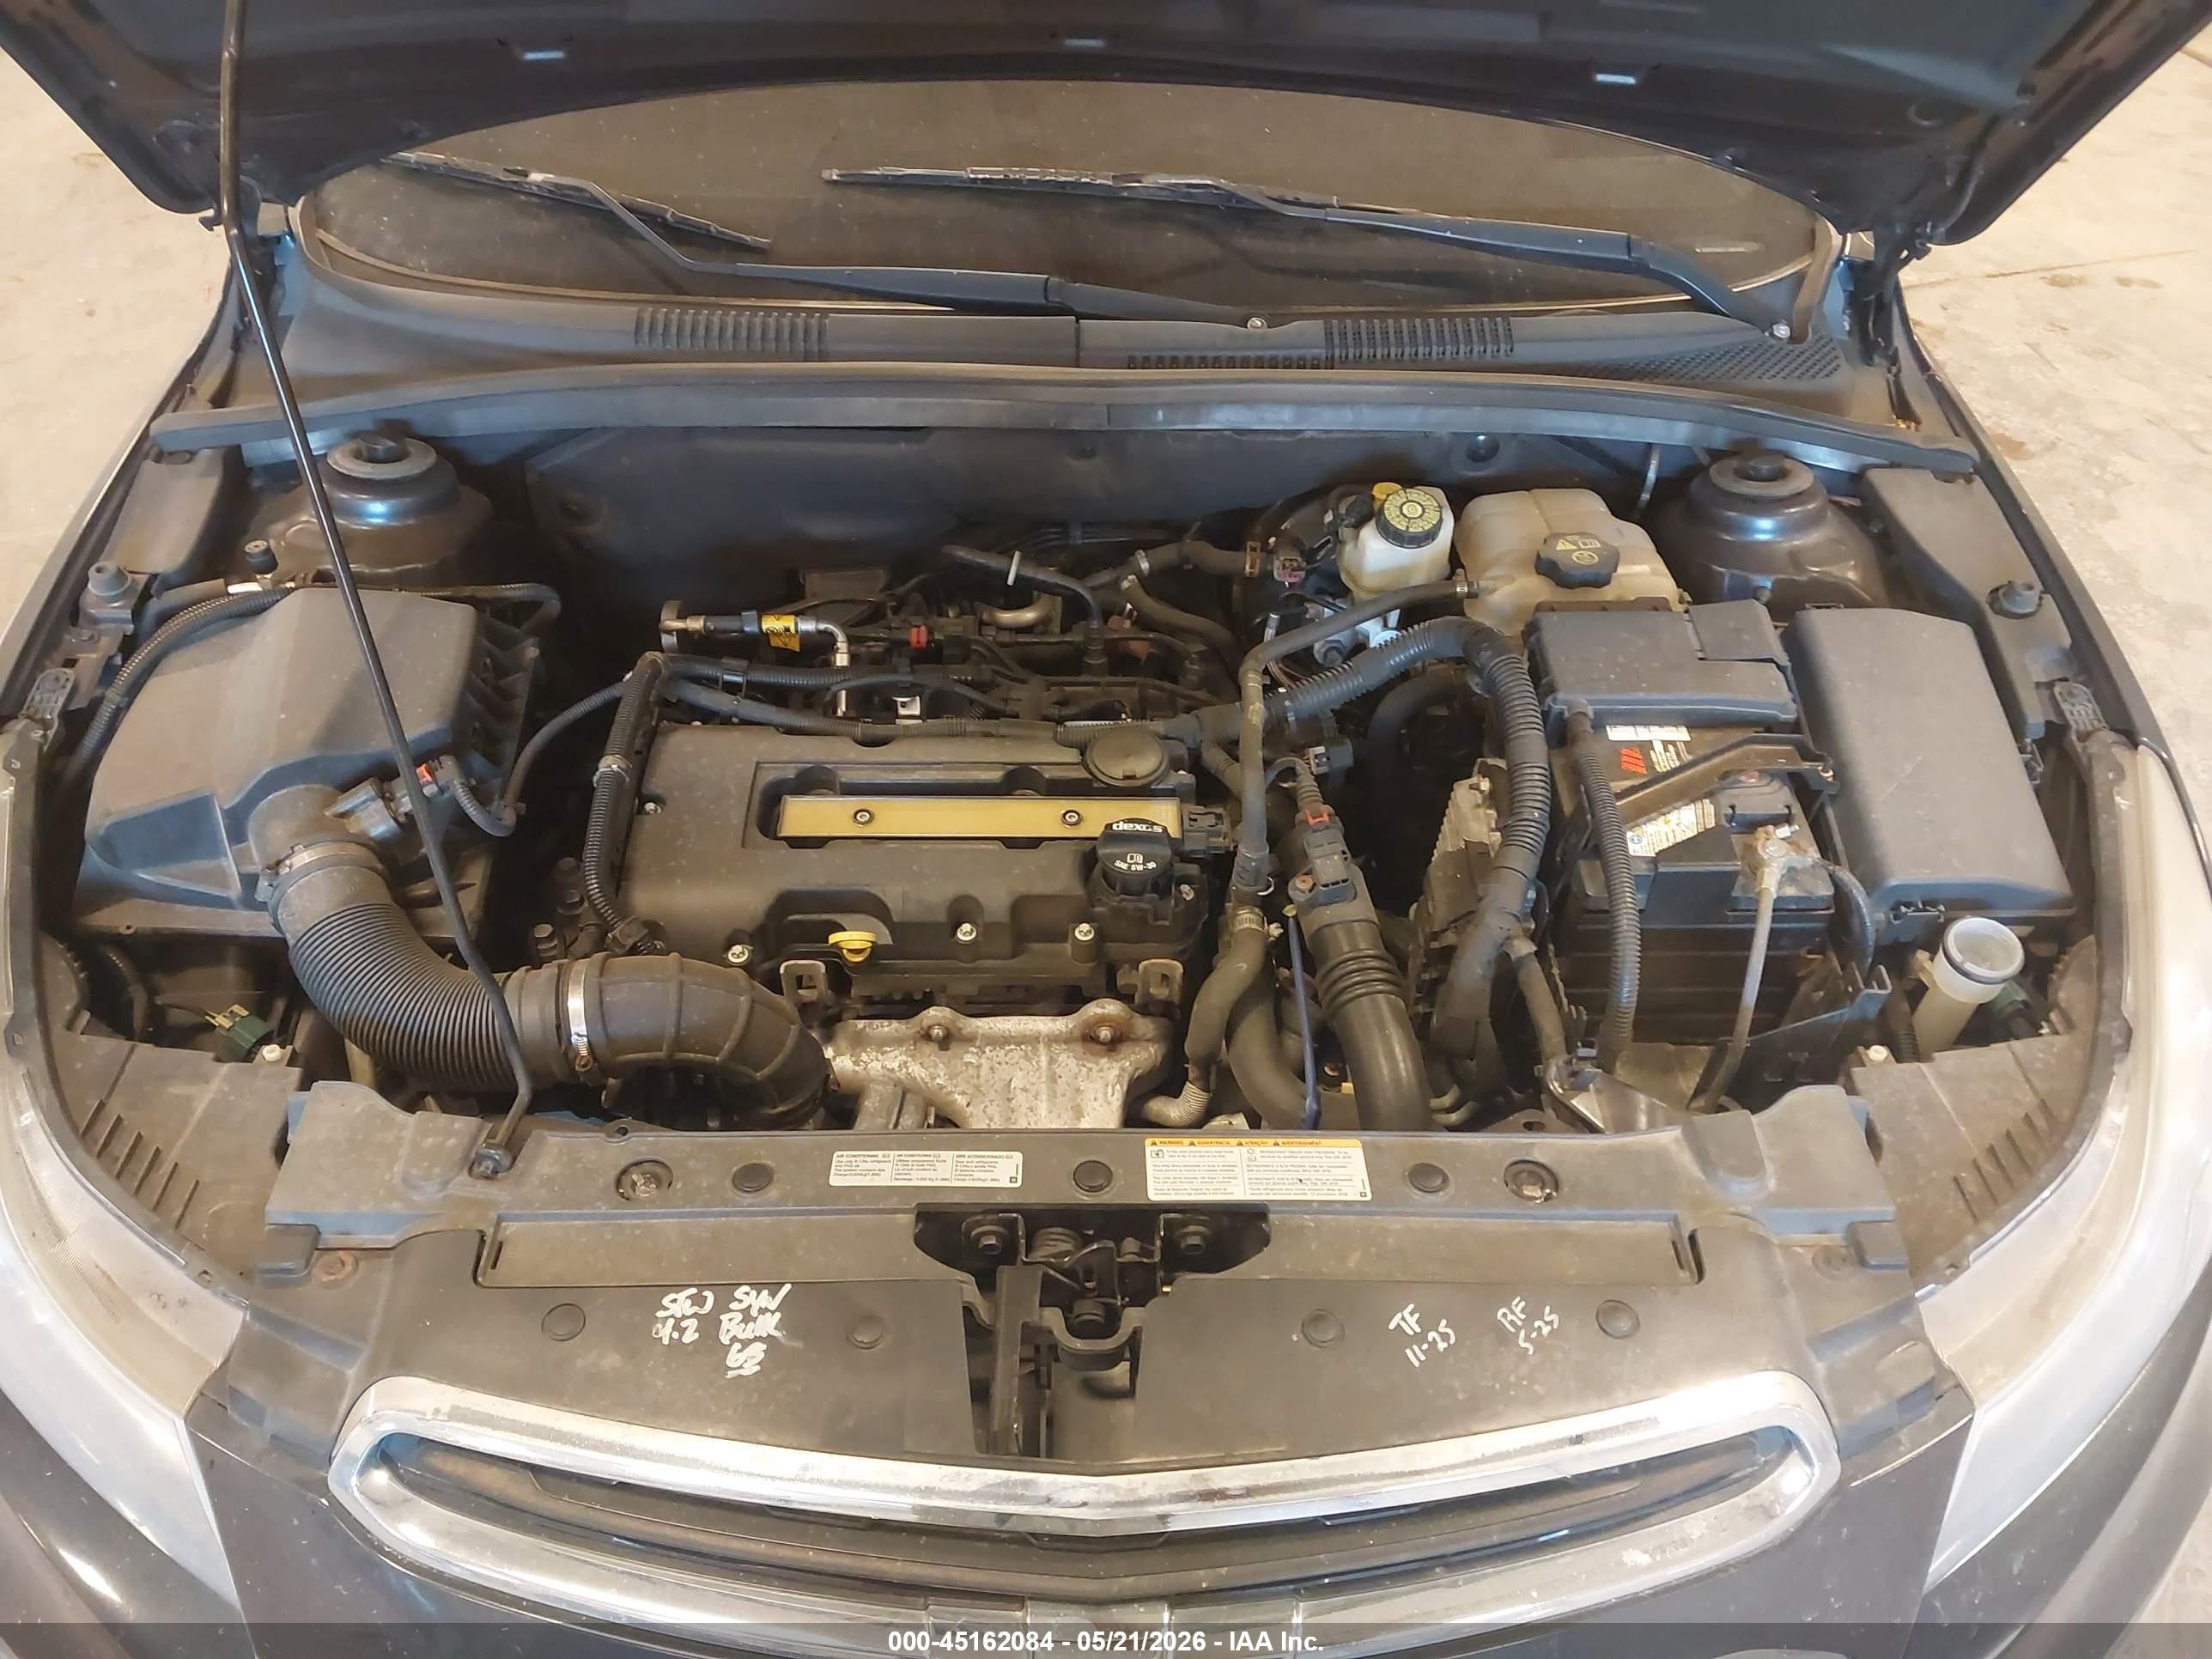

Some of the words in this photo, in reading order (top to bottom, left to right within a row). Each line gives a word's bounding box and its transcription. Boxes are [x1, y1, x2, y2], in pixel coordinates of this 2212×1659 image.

[1114, 860, 1129, 871] SAE
[1130, 861, 1158, 872] 5W-30
[1388, 1303, 1422, 1336] TF
[1497, 1295, 1527, 1334] RF
